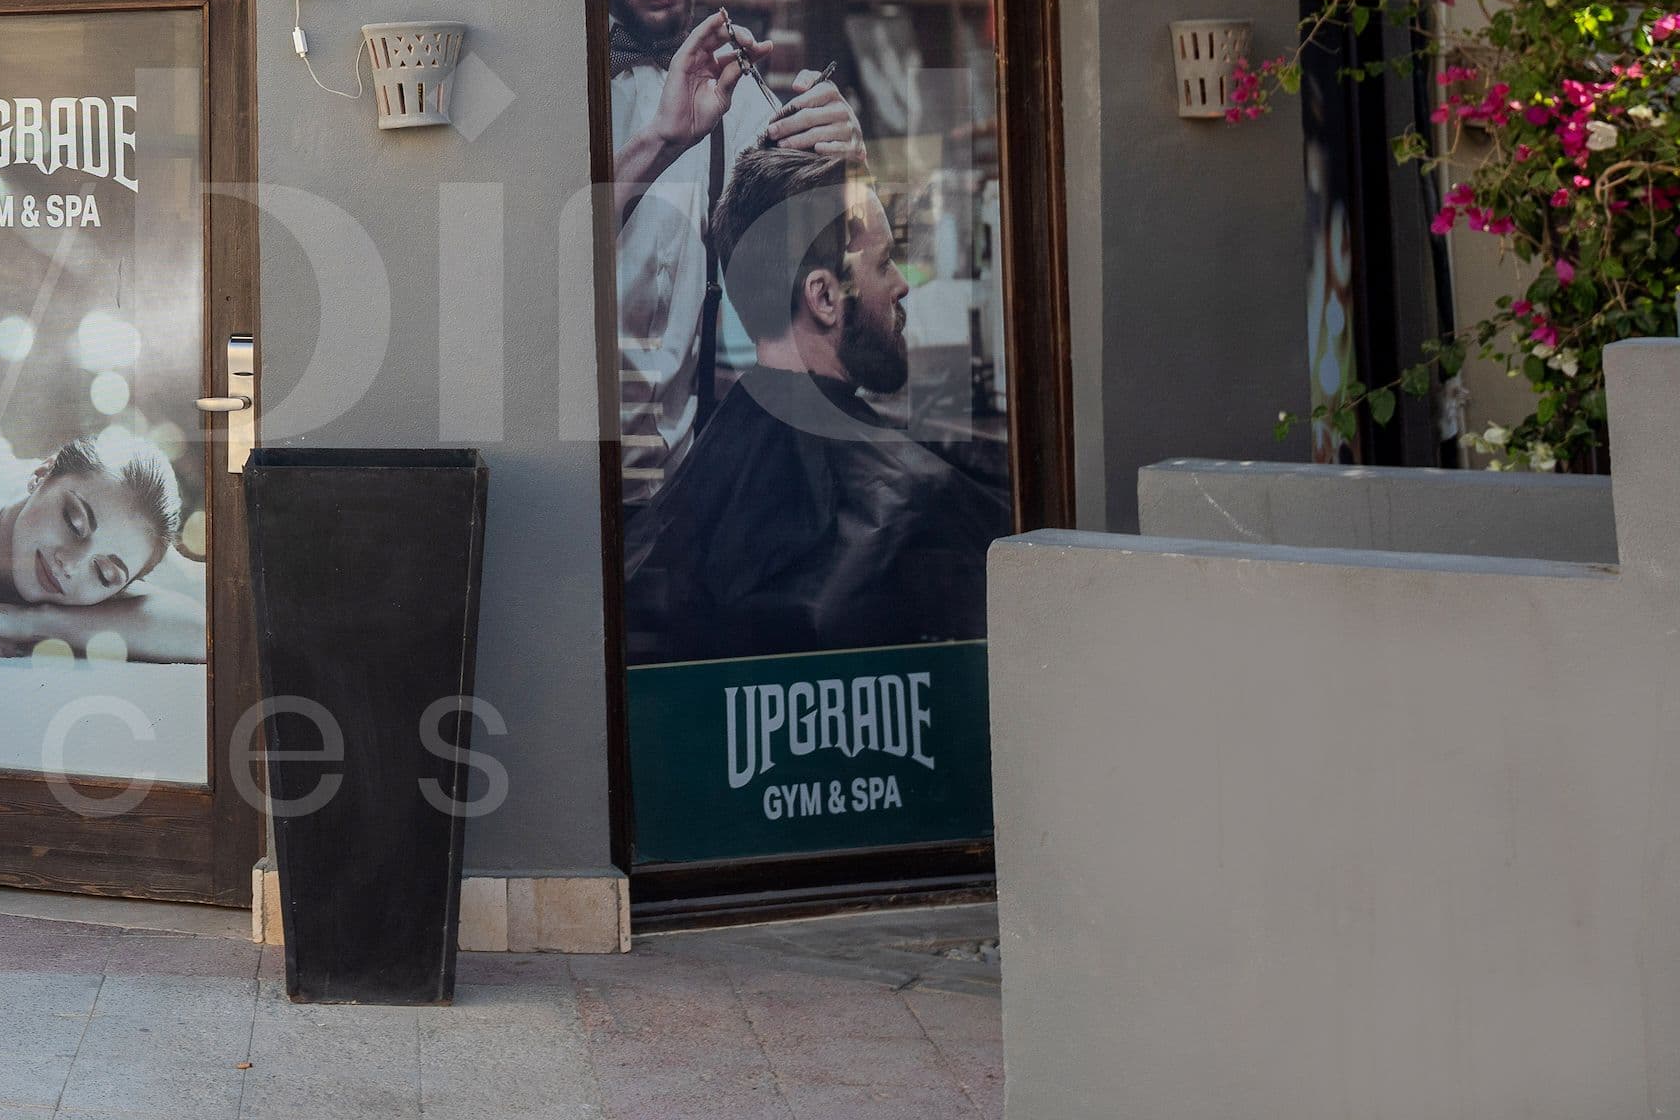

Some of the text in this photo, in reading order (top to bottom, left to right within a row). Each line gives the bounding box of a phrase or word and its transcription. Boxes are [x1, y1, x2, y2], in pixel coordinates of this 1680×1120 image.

[21, 195, 40, 228] &
[46, 194, 101, 228] SPA
[724, 672, 935, 789] UPGRADE
[763, 775, 902, 820] GYM & SPA
